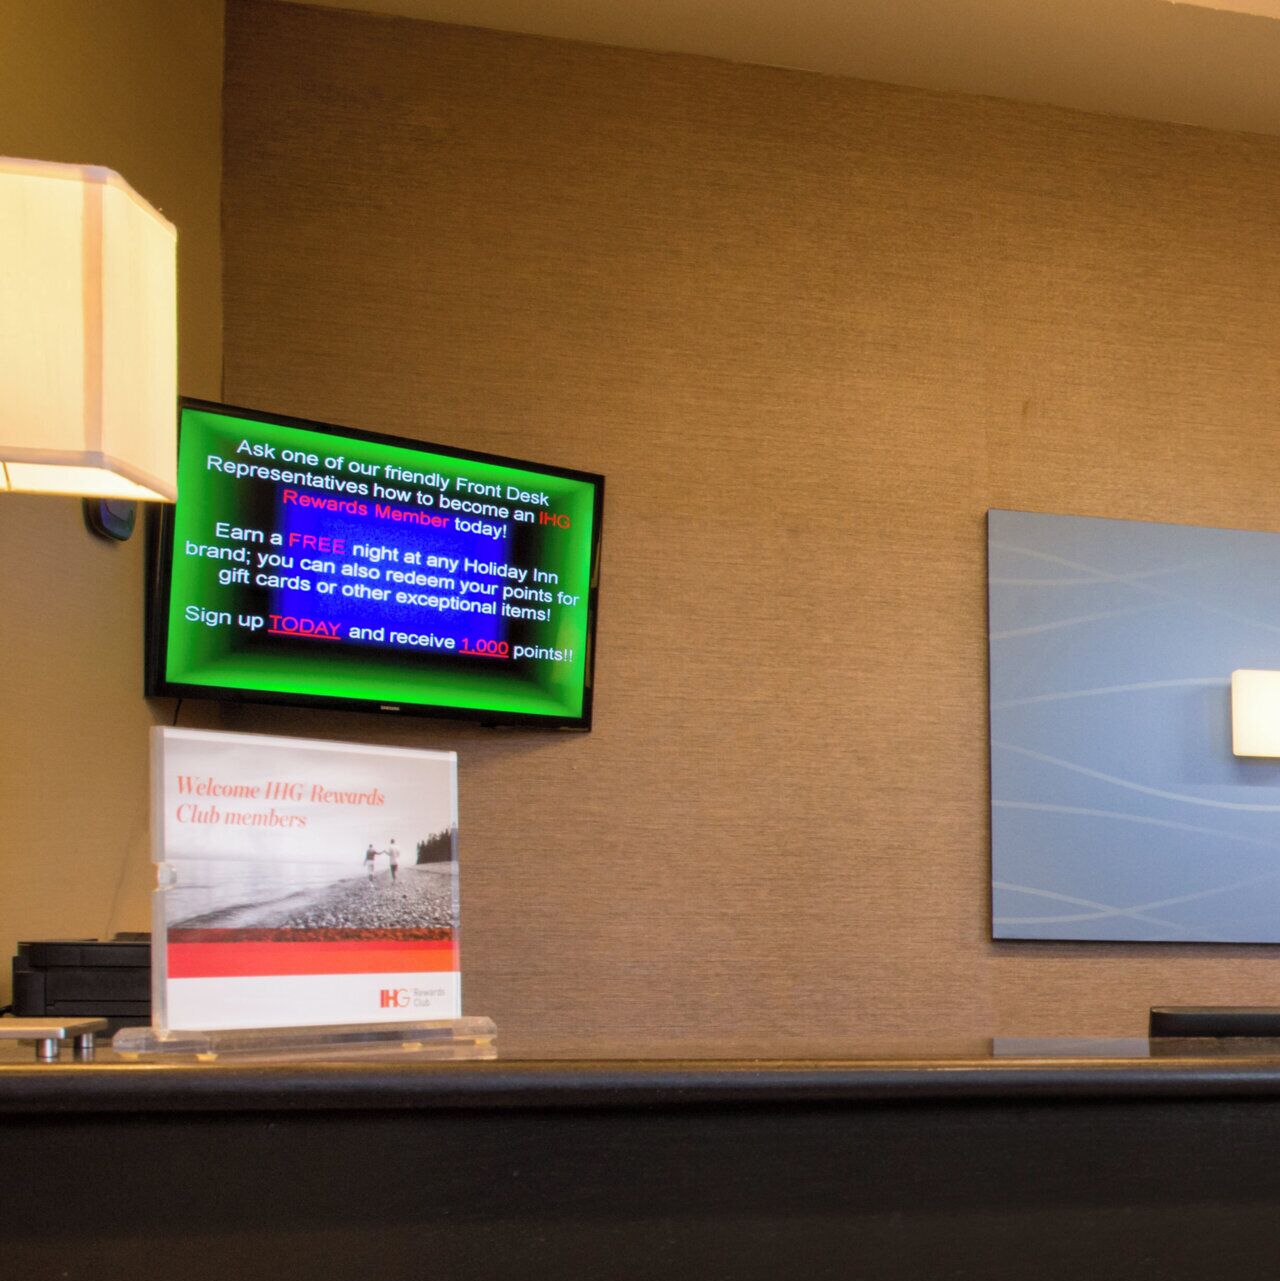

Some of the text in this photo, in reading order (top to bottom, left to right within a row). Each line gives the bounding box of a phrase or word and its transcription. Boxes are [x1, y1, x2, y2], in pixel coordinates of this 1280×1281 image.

[207, 455, 571, 529] Representatives how to become an IHG
[236, 439, 550, 507] Ask one of our friendly Front Desk
[283, 489, 508, 540] Rewards Member today!
[185, 540, 580, 606] brand; you can also redeem your points for
[215, 522, 559, 585] Earn a FREE night at any Holiday Inn
[218, 568, 551, 622] gift cards or other exceptional items!
[185, 605, 232, 627] Sign
[238, 614, 264, 631] up
[269, 614, 341, 638] TODAY
[349, 627, 384, 643] and
[390, 631, 455, 649] receive
[513, 644, 573, 662] points!!
[176, 804, 307, 828] Club members
[177, 775, 385, 806] Welcome IHG Rewards
[380, 988, 410, 1008] IHG
